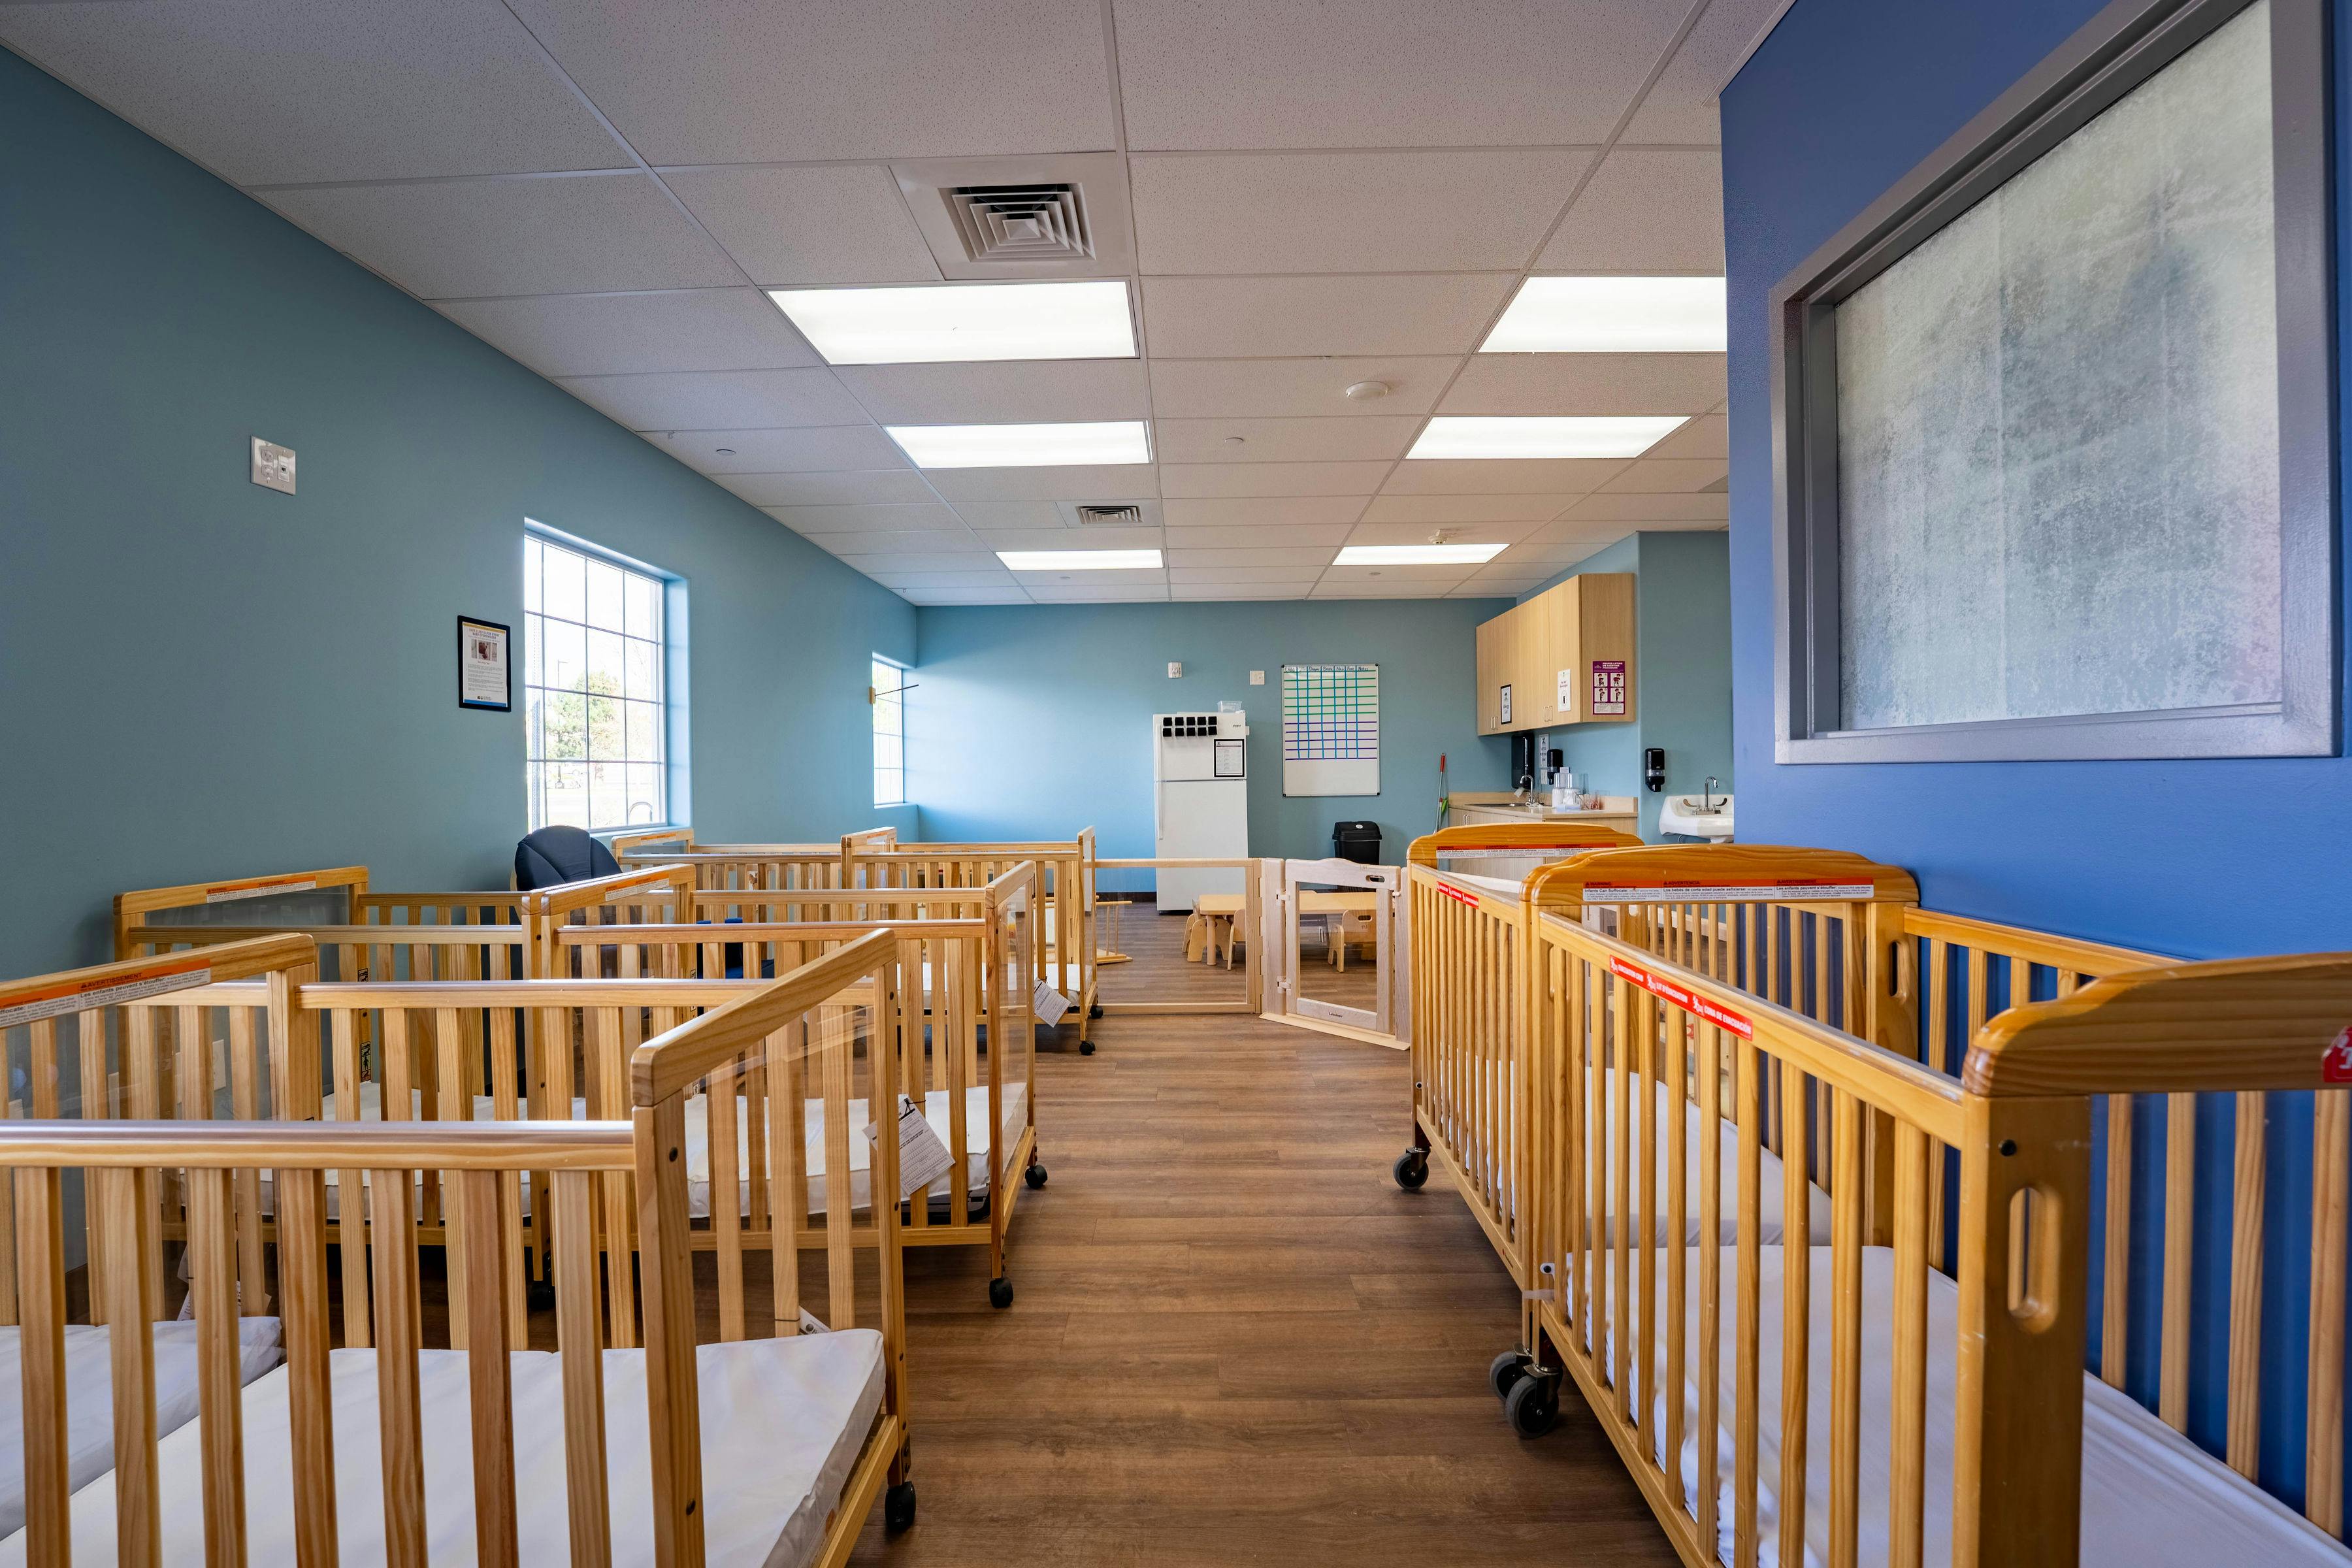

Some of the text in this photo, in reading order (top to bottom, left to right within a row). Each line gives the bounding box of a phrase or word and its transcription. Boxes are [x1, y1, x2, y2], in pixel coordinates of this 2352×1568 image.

[87, 972, 142, 987] AVERTISSEMENT
[93, 987, 114, 996] enfants
[115, 983, 138, 992] peuvent
